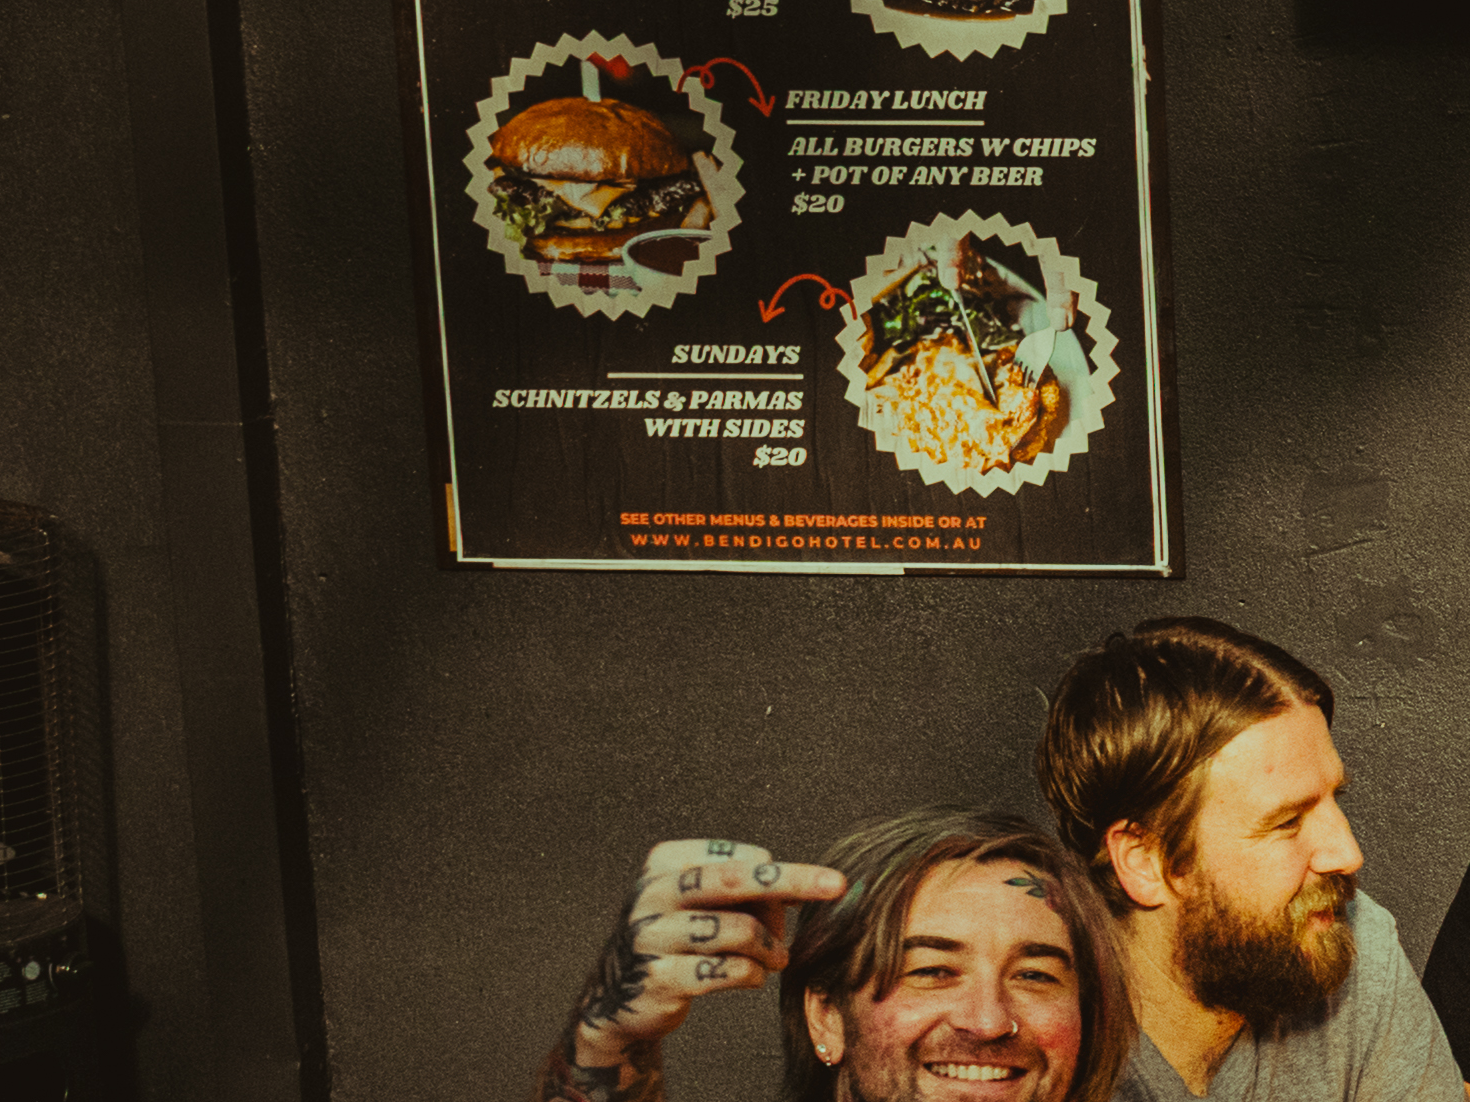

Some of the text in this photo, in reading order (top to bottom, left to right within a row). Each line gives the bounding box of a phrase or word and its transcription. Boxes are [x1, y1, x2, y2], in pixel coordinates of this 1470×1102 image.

[727, 0, 778, 18] $25
[785, 90, 987, 111] FRIDAY LUNCH
[788, 137, 1097, 158] ALL BURGERS W CHIPS
[811, 165, 869, 185] POT
[871, 165, 907, 186] OF
[908, 165, 969, 186] ANY
[970, 166, 1043, 187] BEER
[791, 192, 845, 215] $20
[671, 345, 801, 365] SUNDAYS
[492, 388, 804, 412] SCHNITZELS & PARMAS
[643, 417, 806, 439] WITH SIDES
[752, 445, 807, 468] $20
[620, 512, 987, 530] SEE OTHER MENUS & BEVERAGES INSIDE OR AT
[630, 533, 982, 551] WWW.BENDIGOHOTEL.COM.AU
